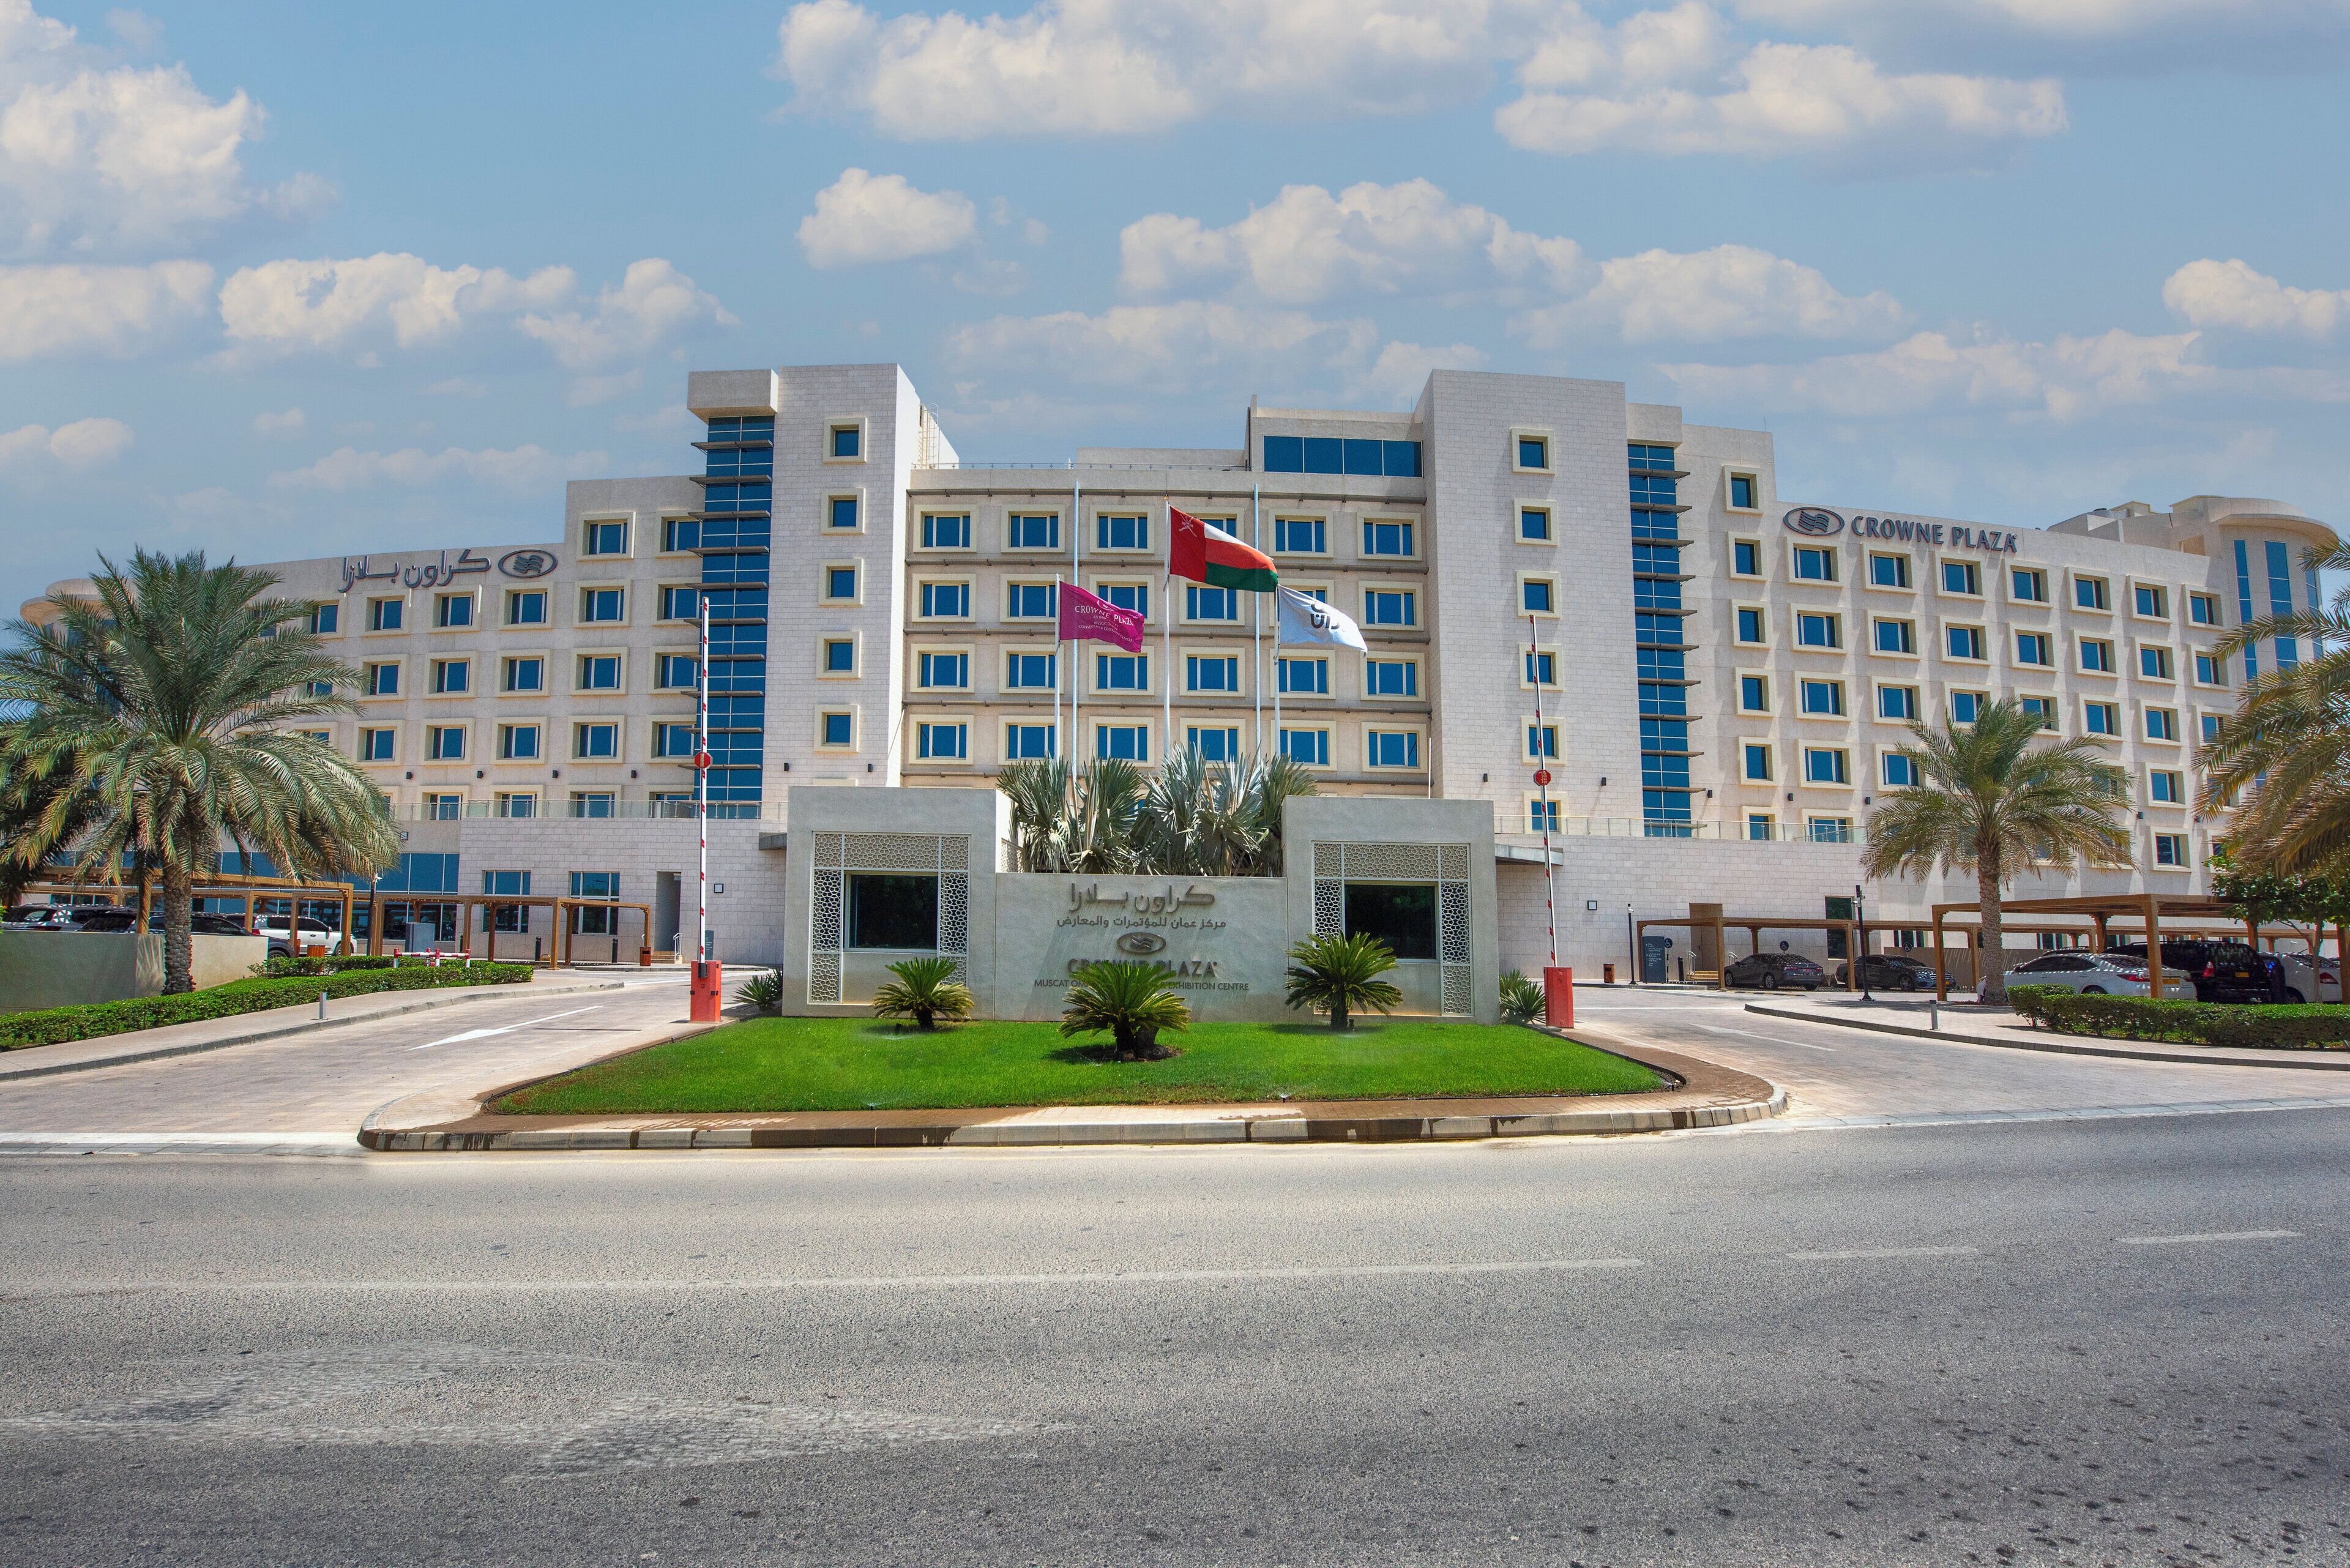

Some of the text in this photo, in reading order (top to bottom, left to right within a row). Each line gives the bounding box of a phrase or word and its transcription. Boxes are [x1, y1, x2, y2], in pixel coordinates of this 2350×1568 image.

[1852, 515, 2018, 553] CROWNE PLAZA
[338, 549, 491, 593] كراون بلازا
[1075, 605, 1111, 619] CROWNE
[1069, 883, 1215, 913] كراون بلازا
[1057, 916, 1226, 930] مركز عمان للمؤتمرات والمعارض
[1034, 979, 1069, 988] MUSCAT
[1168, 981, 1215, 990] EXHIBITION
[1217, 982, 1249, 991] CENTRE
